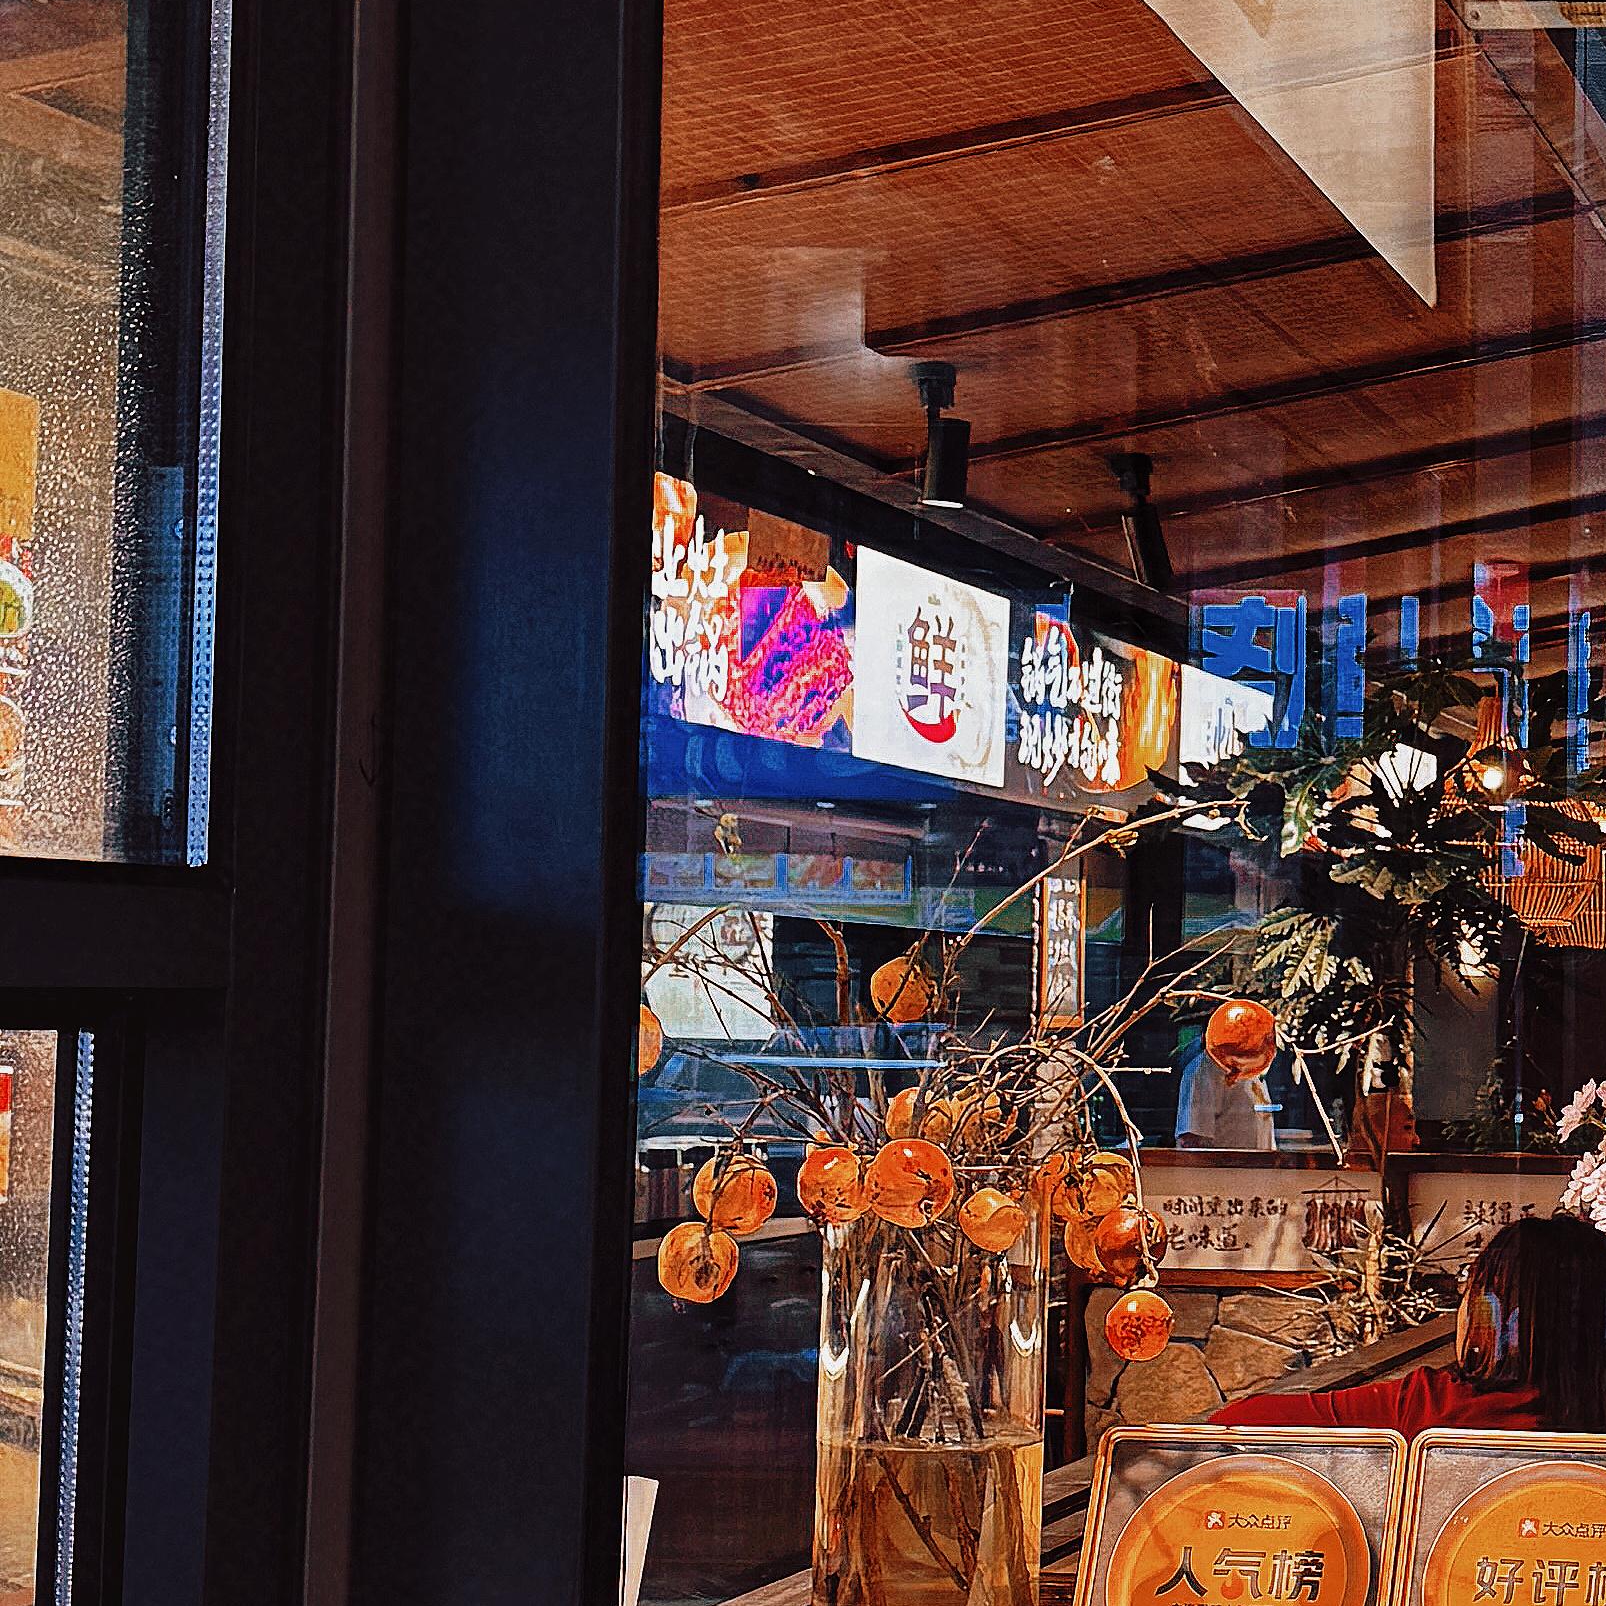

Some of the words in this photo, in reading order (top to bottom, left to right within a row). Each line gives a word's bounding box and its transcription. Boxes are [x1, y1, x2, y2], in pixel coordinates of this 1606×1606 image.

[1228, 1513, 1292, 1531] 大众点评
[1542, 1521, 1606, 1538] 大众点评
[1155, 1547, 1325, 1601] 人气榜
